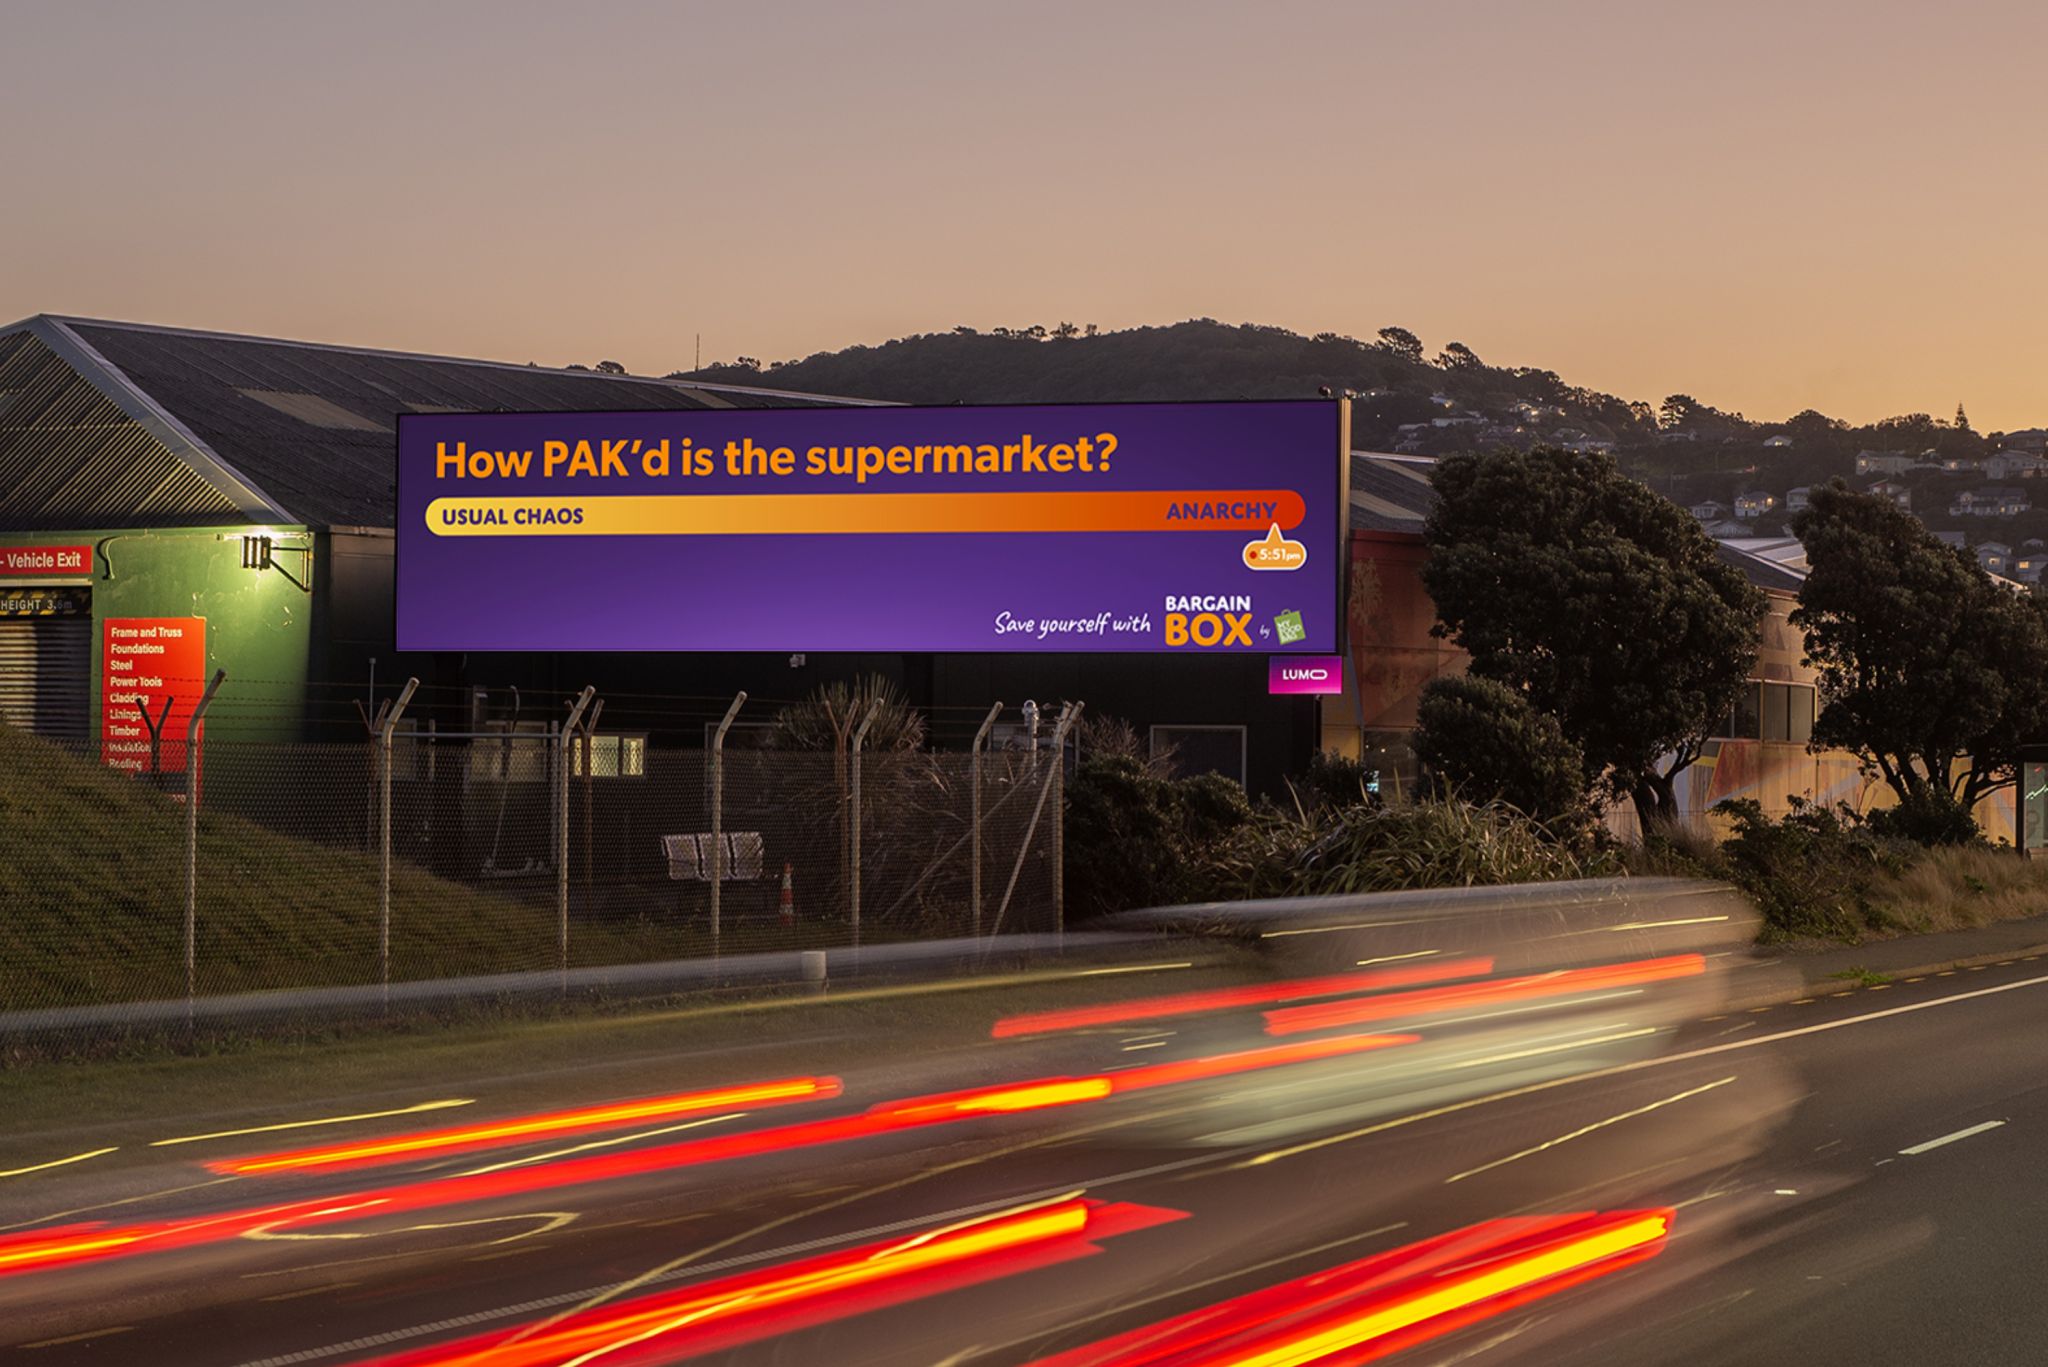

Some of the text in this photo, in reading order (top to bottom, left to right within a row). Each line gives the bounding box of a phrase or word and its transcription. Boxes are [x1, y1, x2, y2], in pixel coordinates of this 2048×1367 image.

[436, 441, 532, 478] How
[682, 438, 714, 476] is
[724, 438, 796, 475] the
[805, 432, 1118, 483] supermarket?
[442, 507, 584, 525] USUAL CHAOS
[1166, 502, 1278, 520] ANARCHY
[7, 552, 54, 568] Vehicle
[57, 551, 81, 567] Exit
[1, 600, 41, 610] HEIGHT
[1165, 596, 1251, 611] BARGAIN
[995, 611, 1151, 639] Save yourself with
[1165, 612, 1253, 646] BOX
[111, 627, 183, 638] Frame and Truss
[1260, 625, 1270, 639] by
[111, 643, 165, 654] Foundations
[110, 660, 133, 670] Steel
[1282, 669, 1328, 680] LUMO
[110, 676, 163, 687] Power Tools
[109, 709, 142, 722] Linings
[109, 725, 140, 736] Timber
